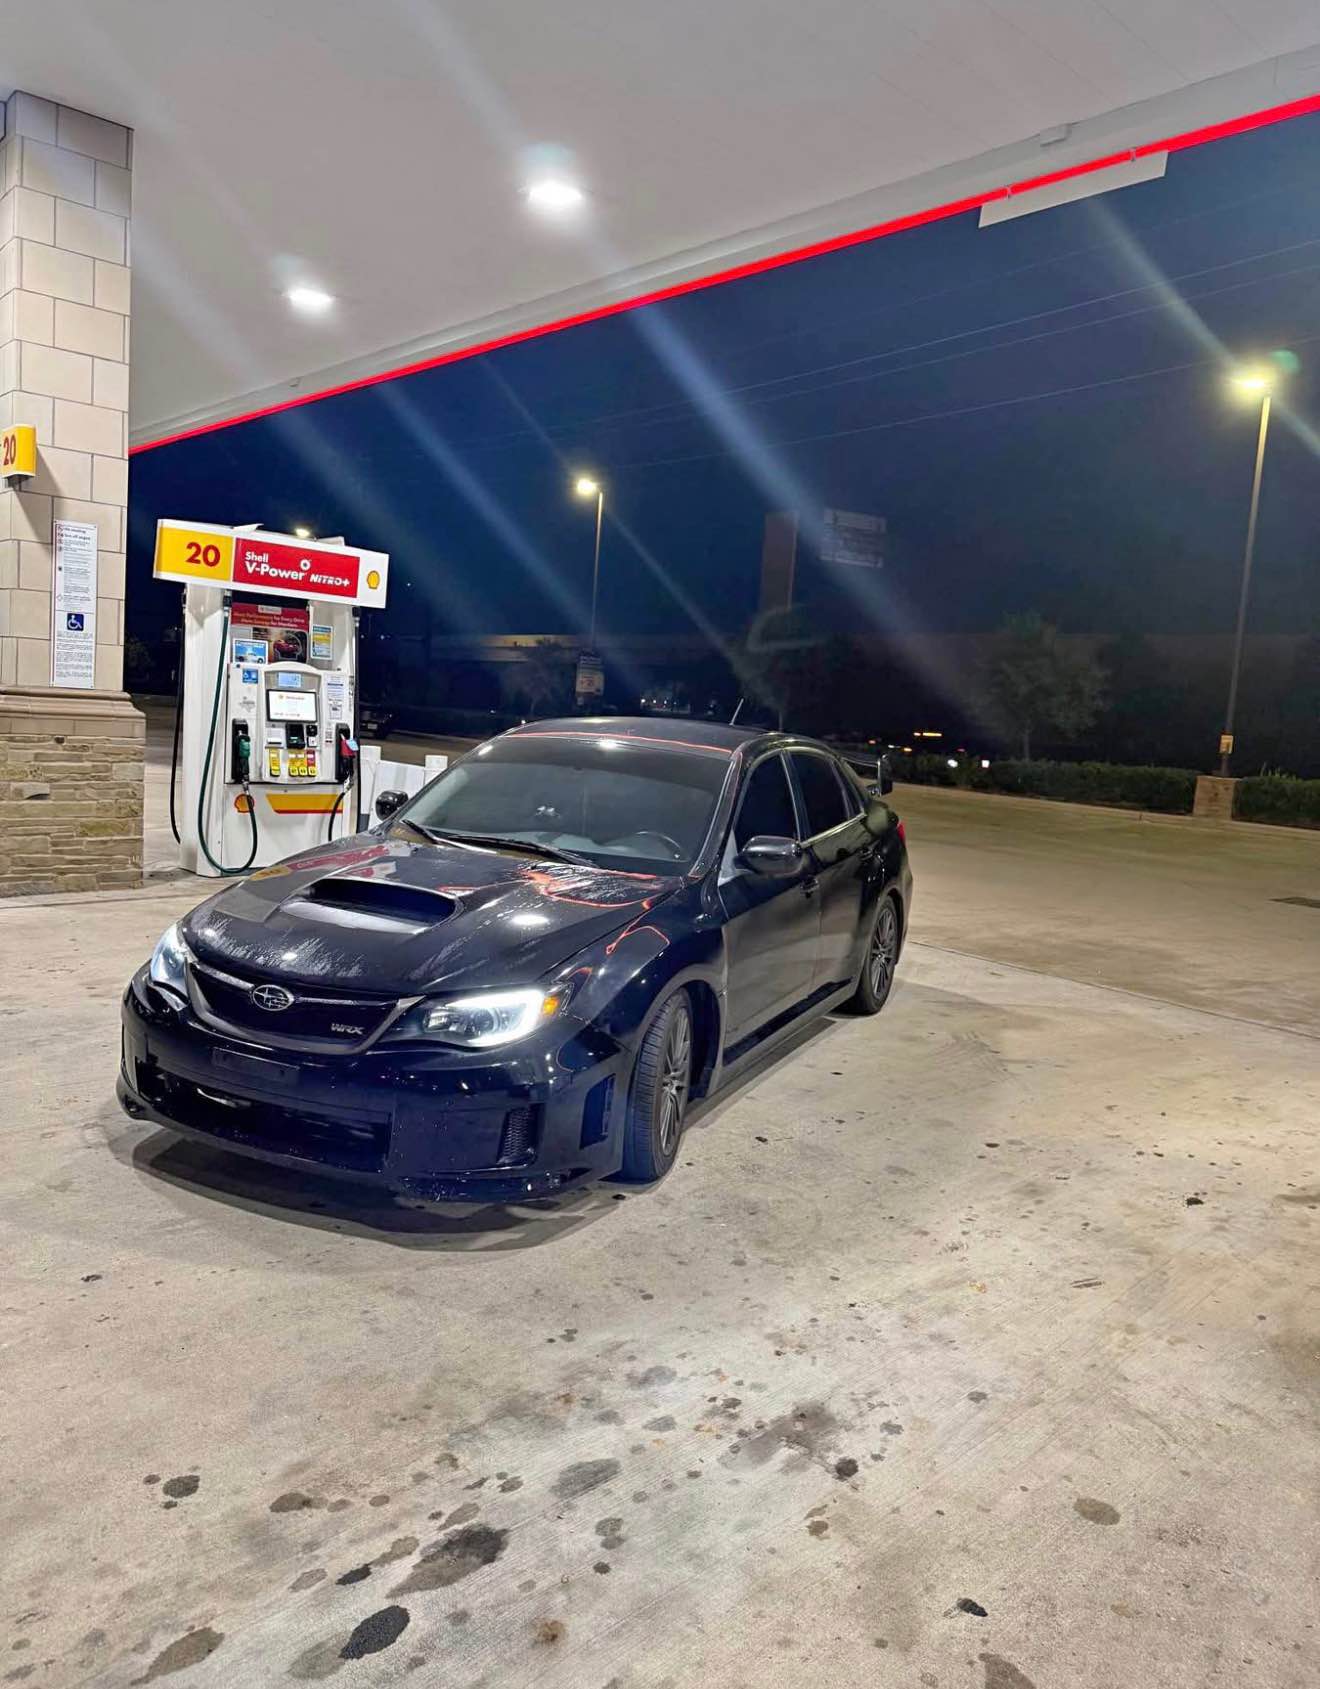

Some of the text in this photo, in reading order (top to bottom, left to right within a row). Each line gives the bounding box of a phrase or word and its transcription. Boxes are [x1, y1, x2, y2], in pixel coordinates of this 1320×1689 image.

[3, 434, 16, 465] 20
[185, 542, 221, 567] 20
[245, 551, 269, 563] Shell
[245, 561, 305, 581] V-Power
[331, 1022, 364, 1035] WRX
